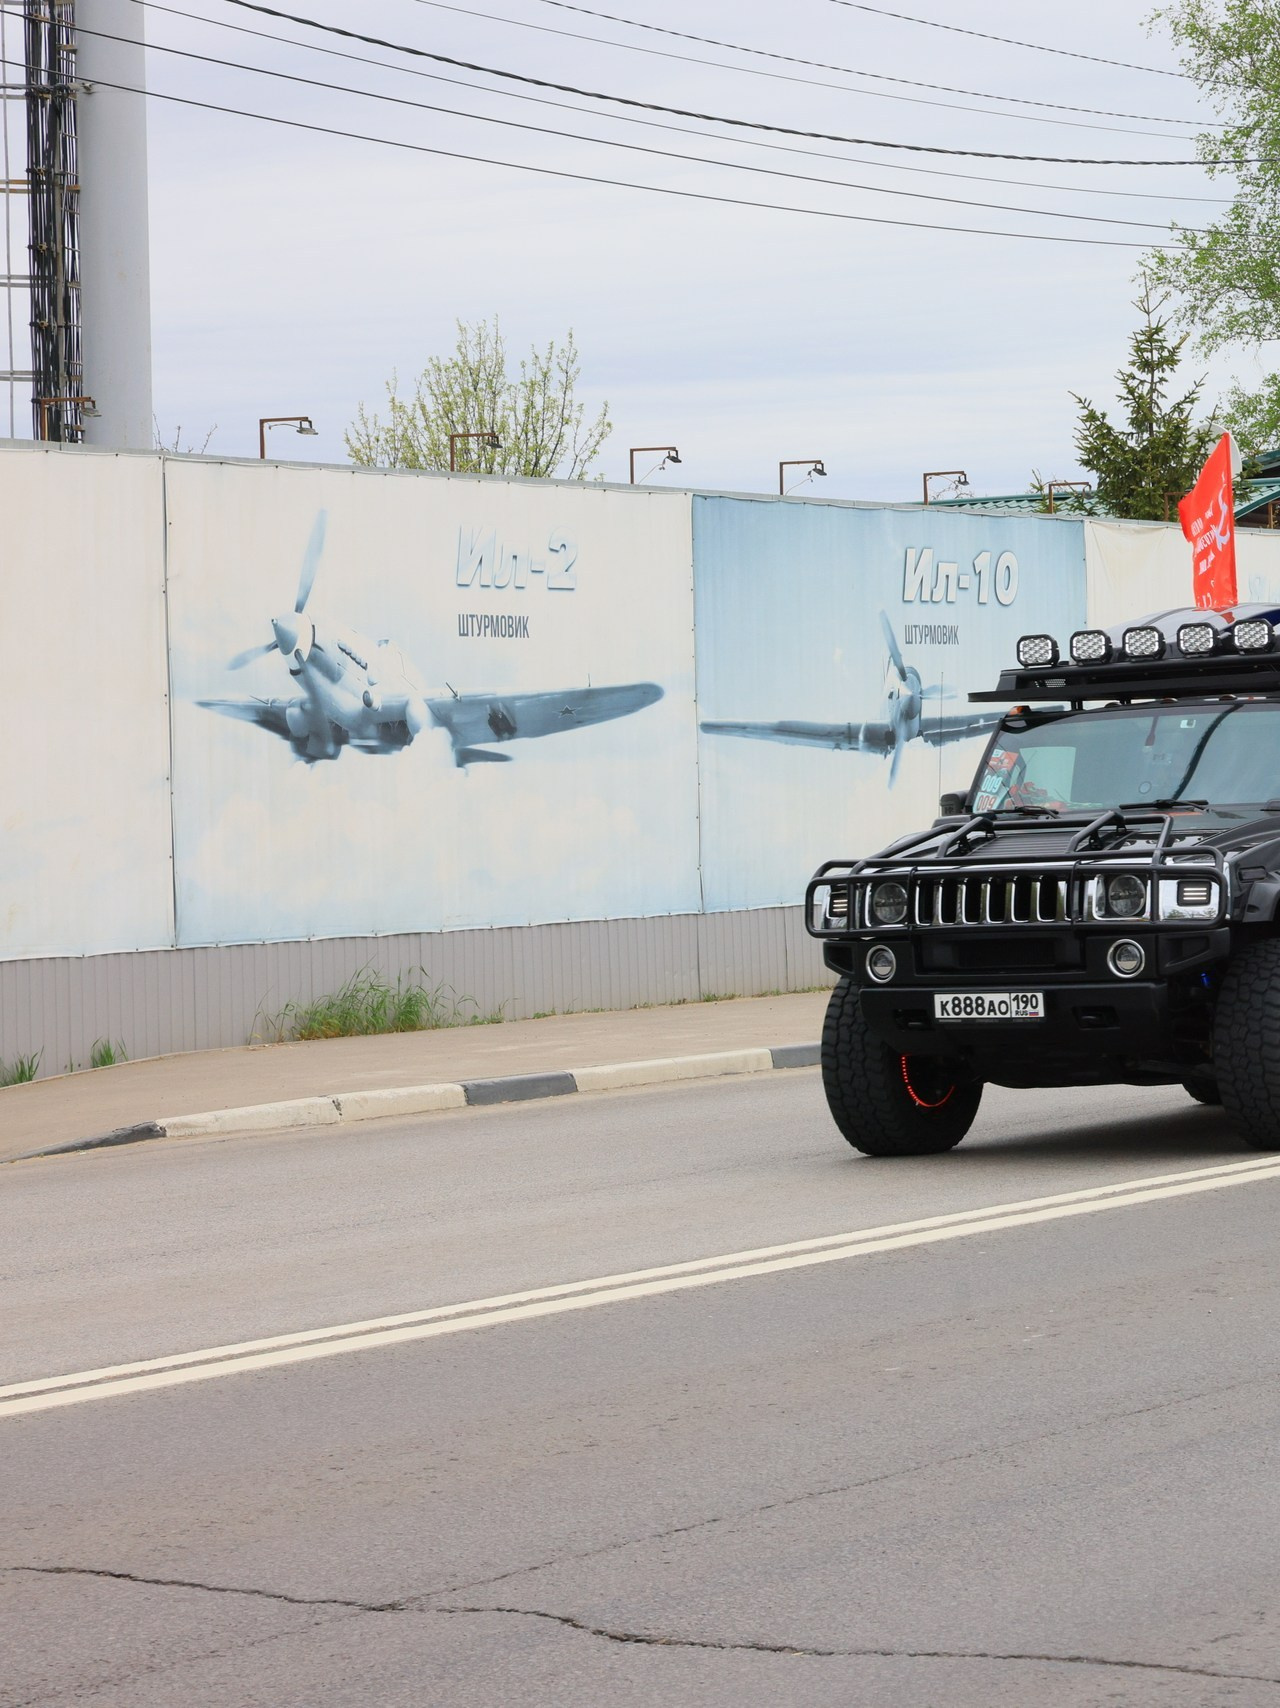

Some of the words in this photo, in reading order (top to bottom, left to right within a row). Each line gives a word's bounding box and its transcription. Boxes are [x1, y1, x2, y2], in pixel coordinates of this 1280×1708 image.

[456, 524, 579, 592] Ил-2
[902, 546, 1019, 607] Ил-10
[458, 613, 530, 639] ШТУРМОВИК
[904, 624, 959, 646] ШТУРМОВИК
[981, 774, 1003, 793] 009
[977, 795, 998, 812] 009
[940, 996, 1009, 1016] К888АО
[1012, 994, 1039, 1009] 190
